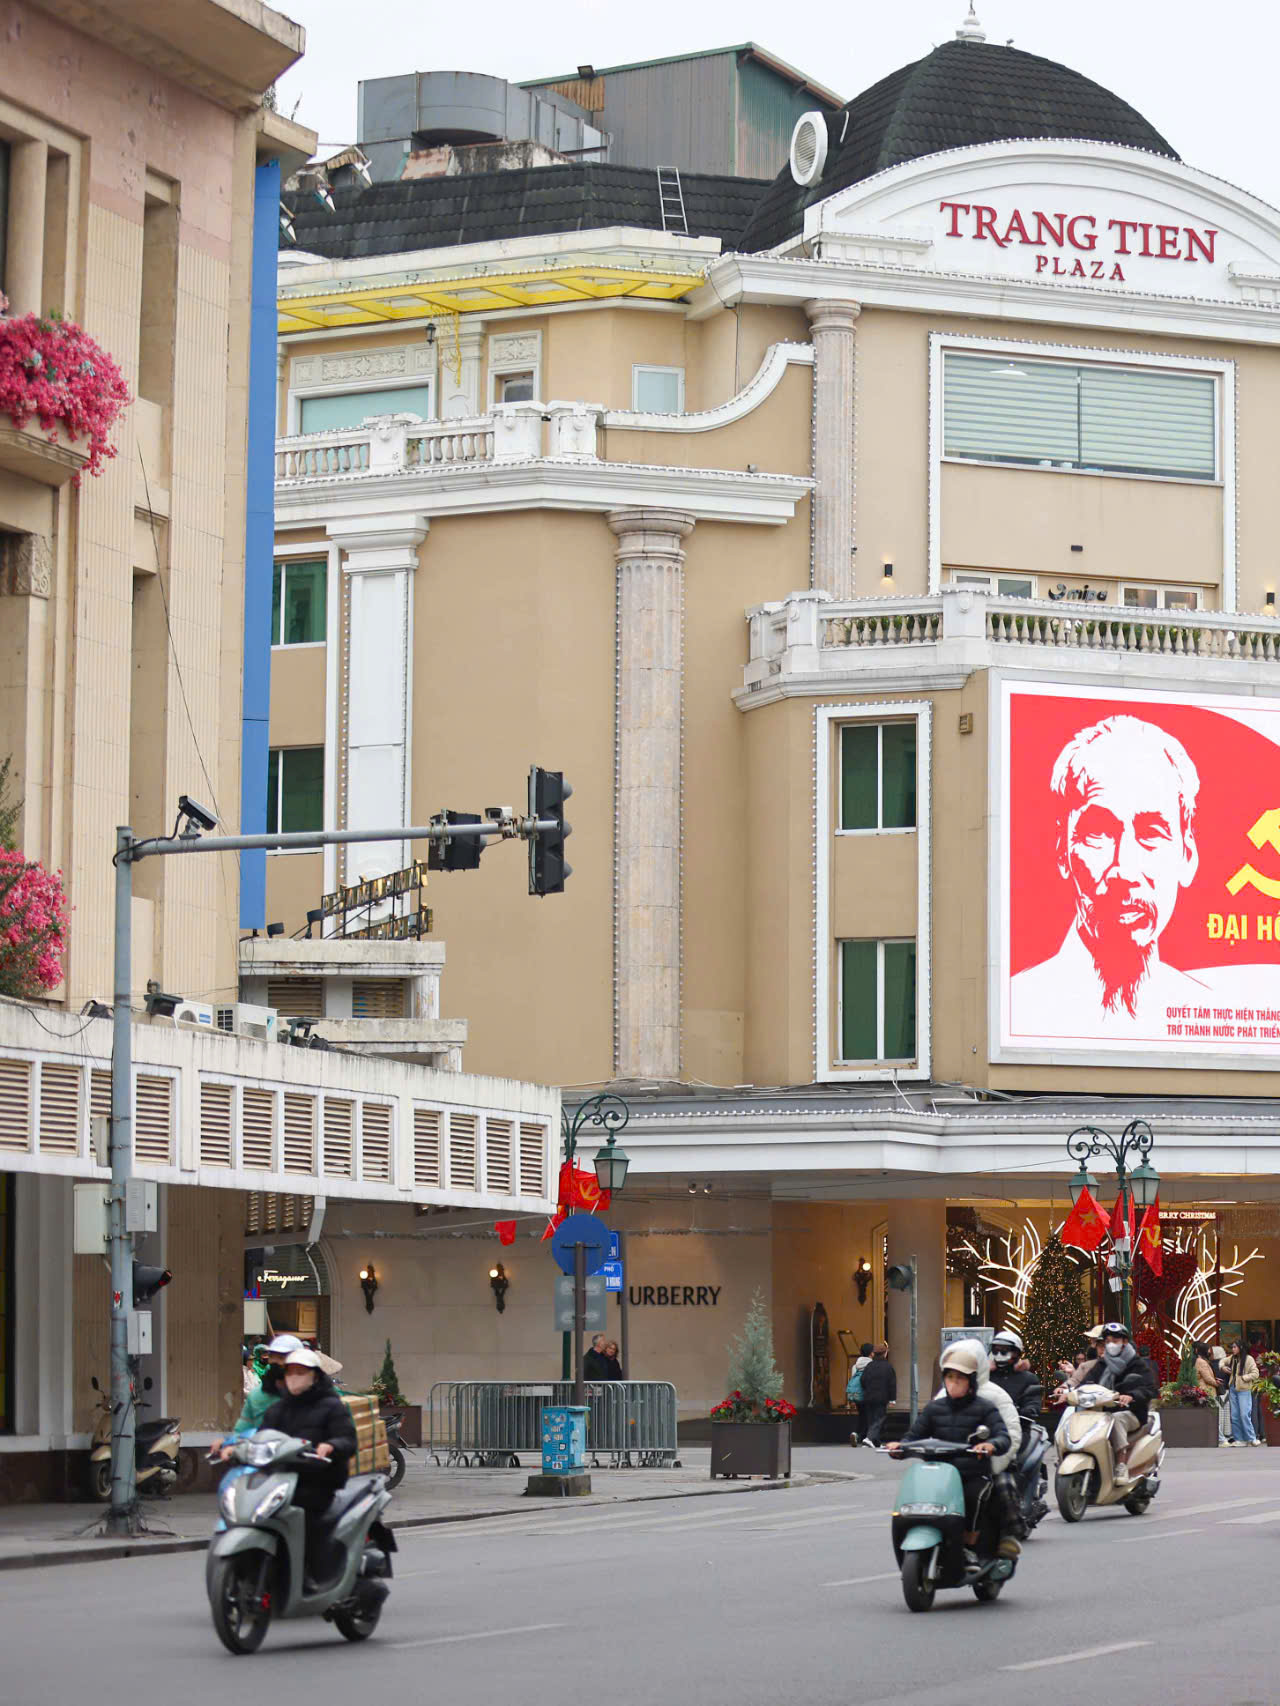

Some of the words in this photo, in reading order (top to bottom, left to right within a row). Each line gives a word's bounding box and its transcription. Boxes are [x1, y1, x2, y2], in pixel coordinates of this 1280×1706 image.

[940, 202, 1097, 250] TRANG
[1108, 219, 1218, 263] TIEN
[1036, 255, 1126, 281] PLAZA
[1207, 913, 1247, 945] ĐẠI
[1166, 1004, 1191, 1019] QUYẾT
[1194, 1006, 1211, 1019] TÂM
[1213, 1008, 1233, 1022] THỰC
[1236, 1008, 1254, 1022] HIỆN
[1167, 1020, 1183, 1035] TRỞ
[1185, 1023, 1211, 1036] THÀNH
[1237, 1024, 1257, 1037] PHÁT
[1158, 1211, 1178, 1219] ERRY
[616, 1286, 721, 1305] URBERRY
